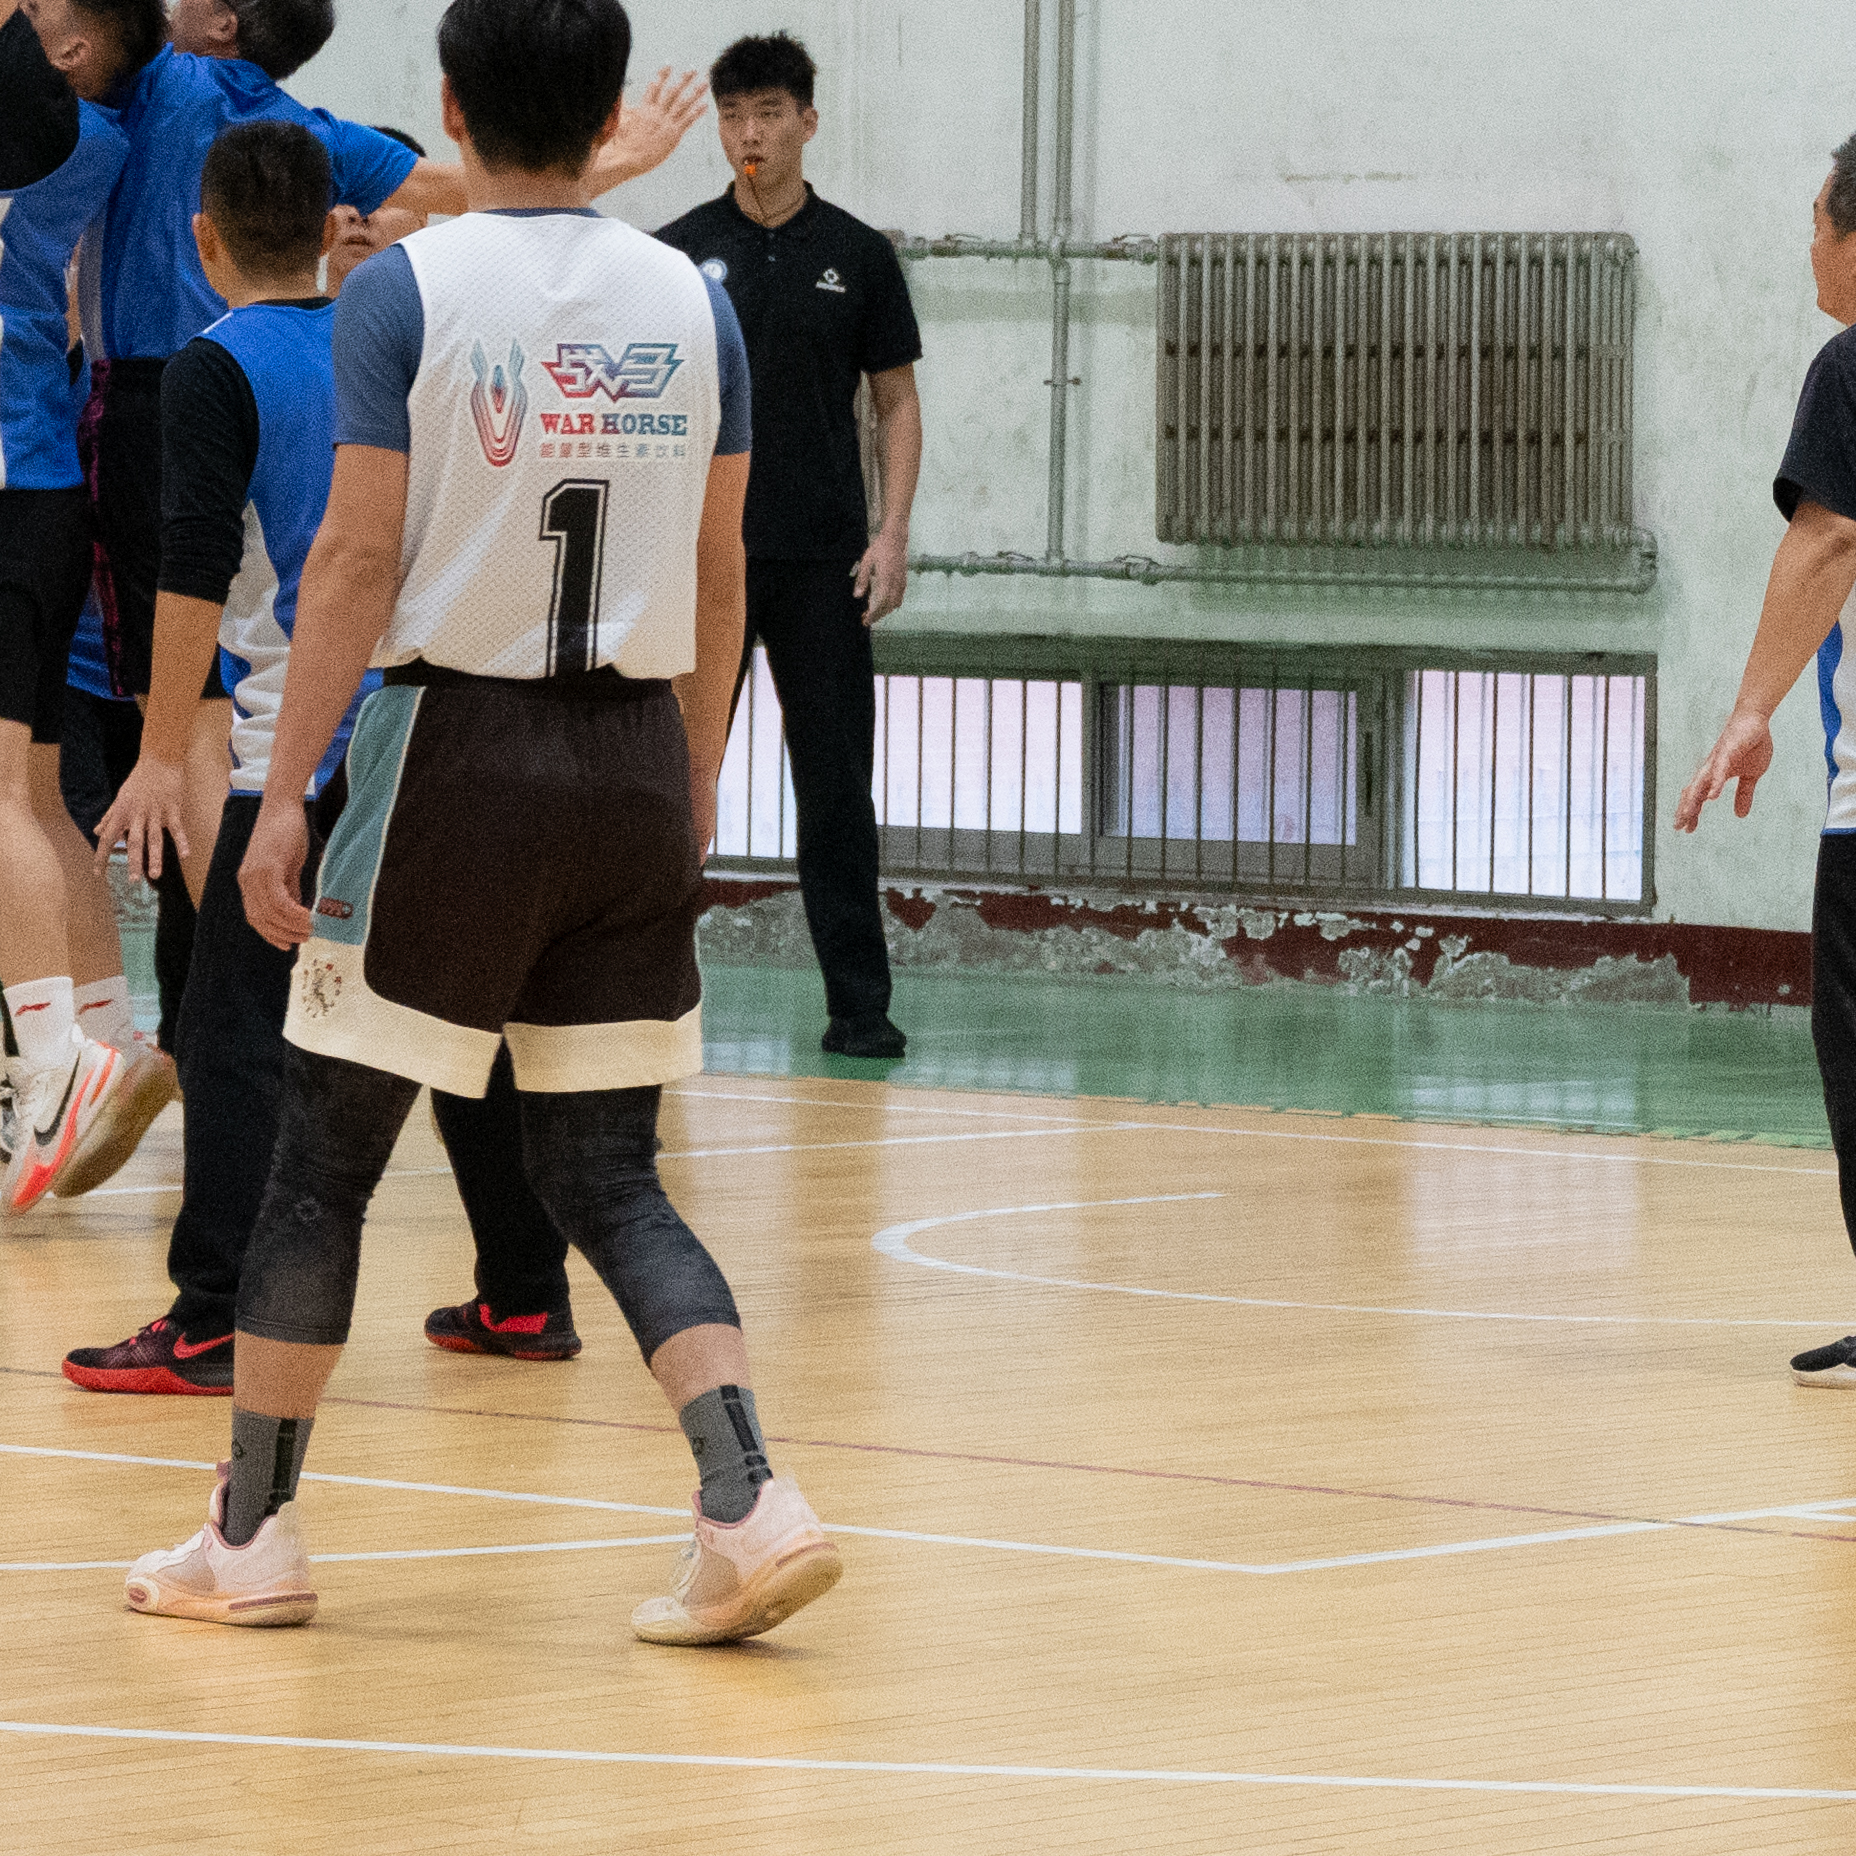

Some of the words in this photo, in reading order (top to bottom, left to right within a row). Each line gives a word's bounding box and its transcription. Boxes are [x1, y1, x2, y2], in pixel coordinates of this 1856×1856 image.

[540, 413, 594, 435] WAR
[600, 413, 688, 436] HORSE
[538, 478, 610, 676] 1
